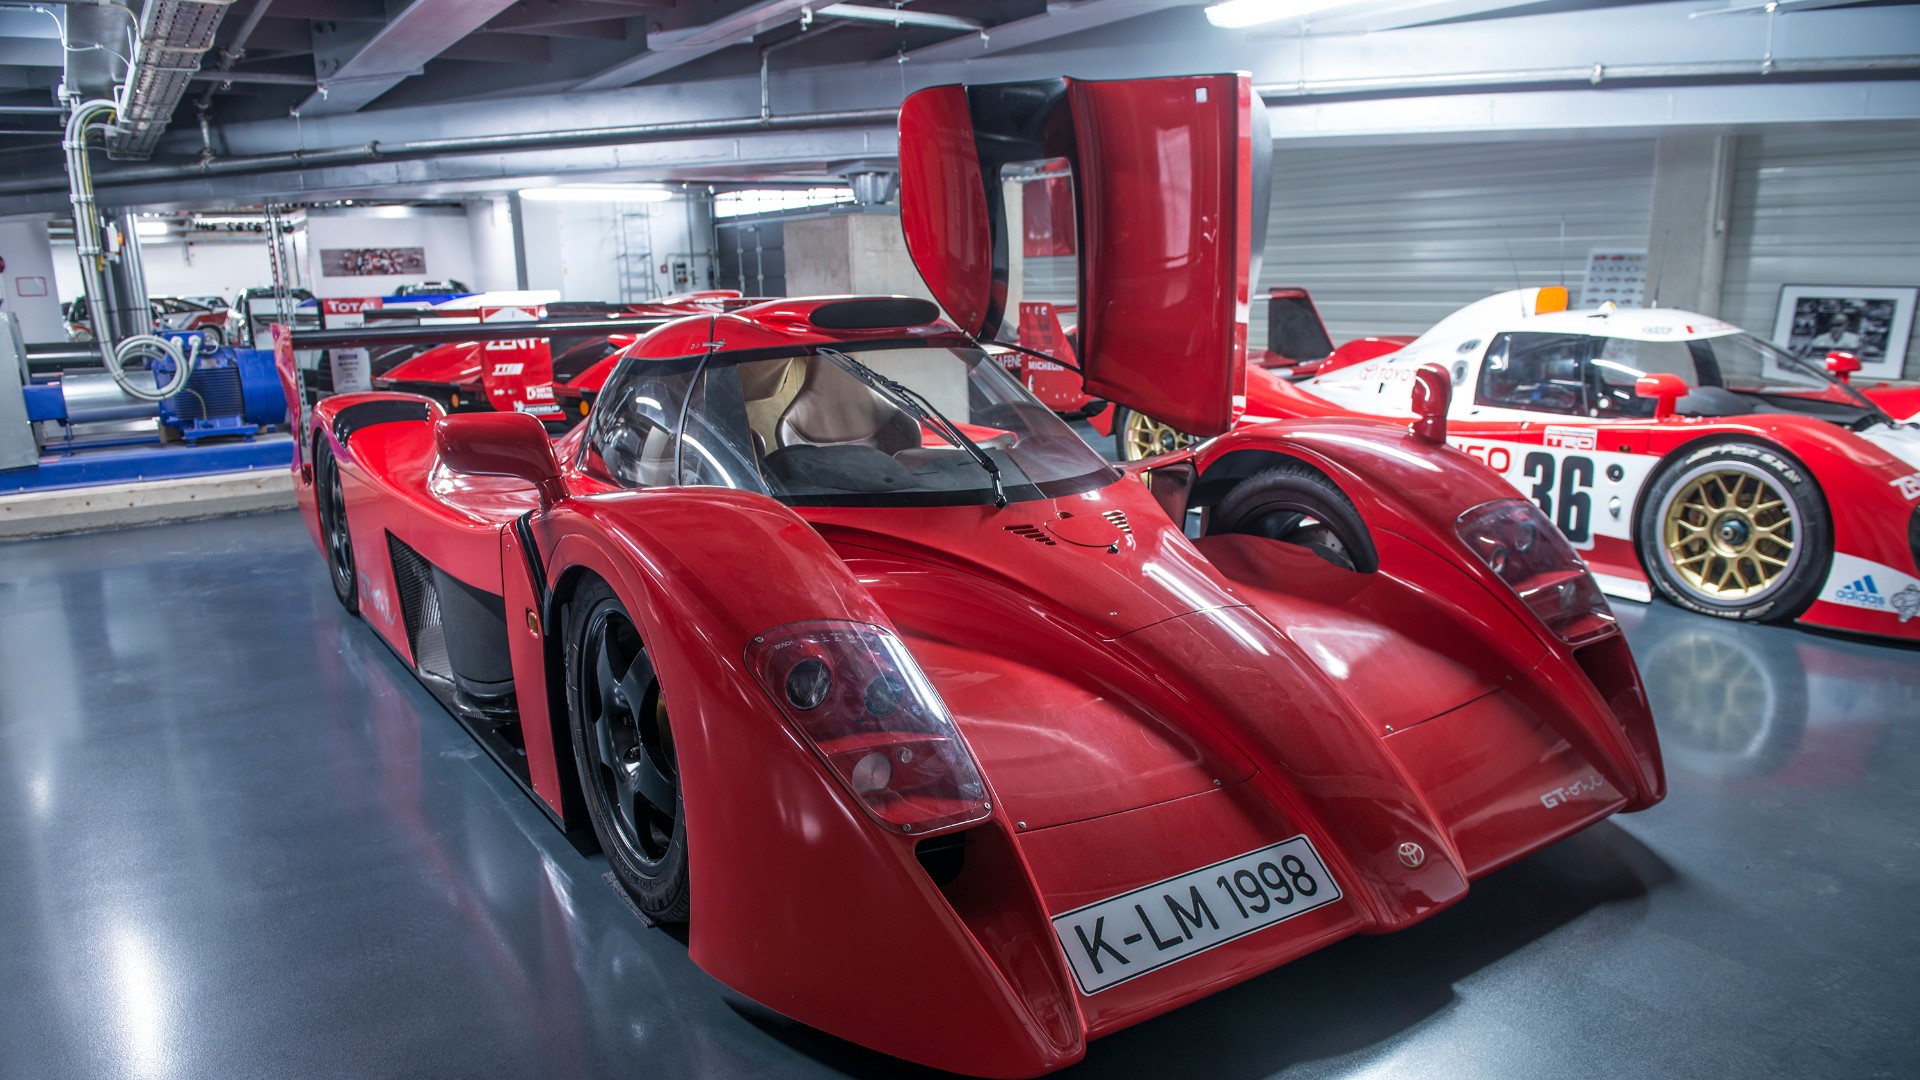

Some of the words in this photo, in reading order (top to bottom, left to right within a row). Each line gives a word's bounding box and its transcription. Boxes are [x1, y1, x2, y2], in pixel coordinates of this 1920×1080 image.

[1380, 367, 1417, 382] TOYO
[1523, 451, 1594, 543] 36
[1836, 589, 1886, 605] adidas
[1539, 774, 1605, 809] GT-one
[1073, 885, 1220, 975] K-LM
[1216, 854, 1318, 920] 1998
